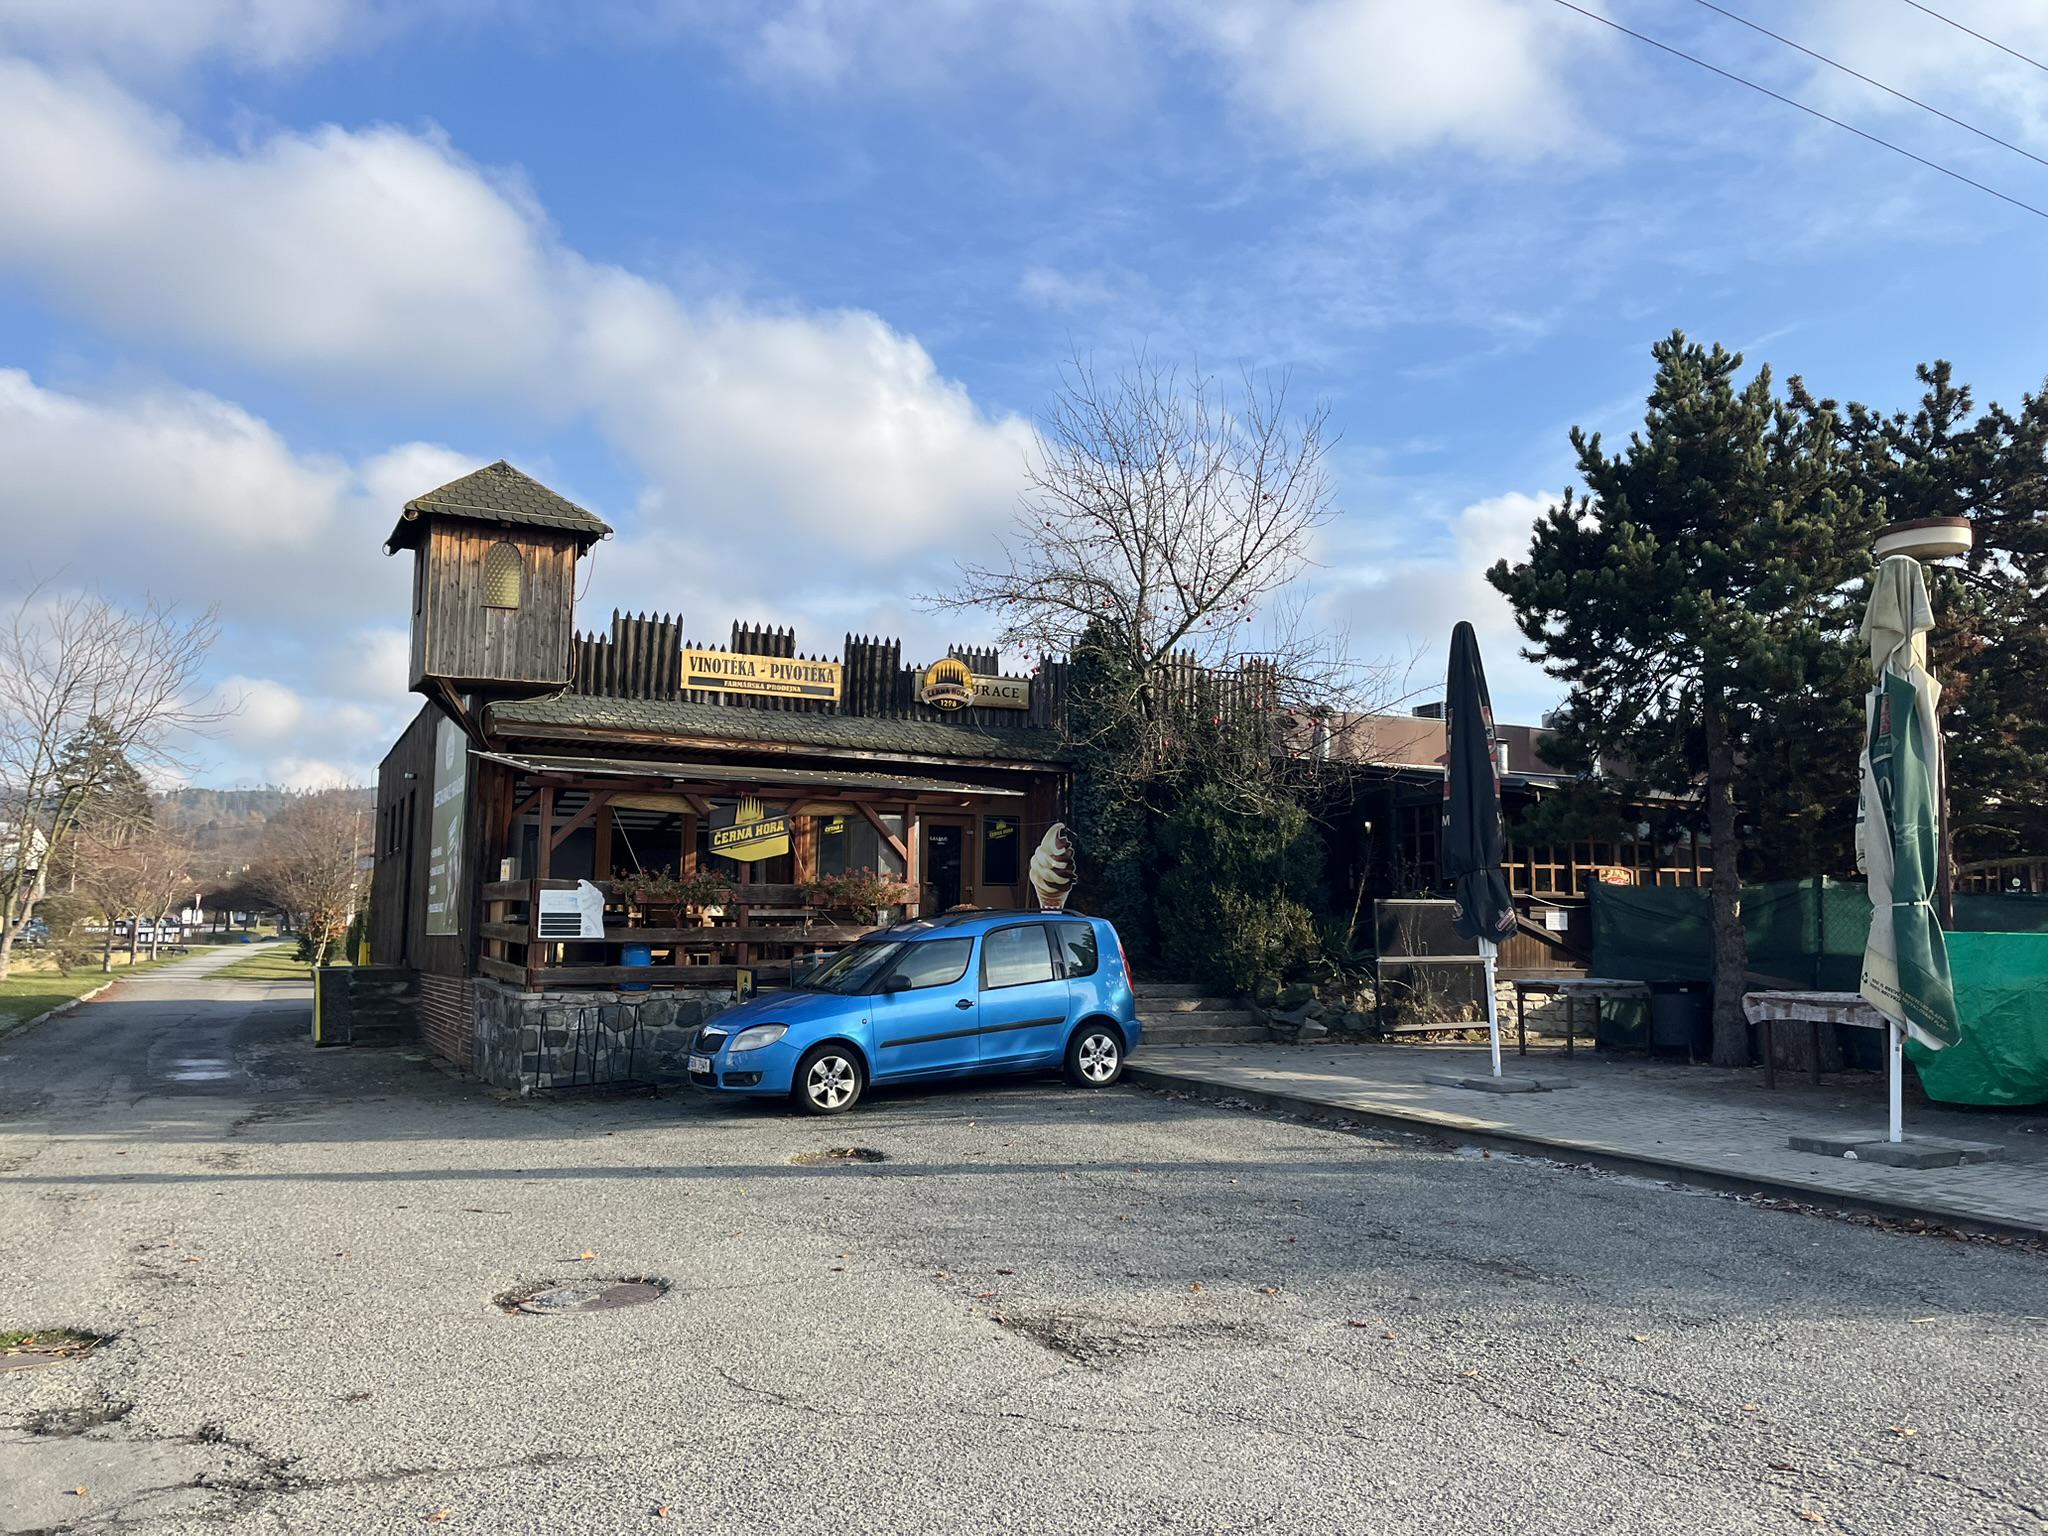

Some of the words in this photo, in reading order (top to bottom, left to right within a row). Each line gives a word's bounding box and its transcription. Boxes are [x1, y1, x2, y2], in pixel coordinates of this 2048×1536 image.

[689, 656, 756, 677] VINOTÉKA
[770, 663, 835, 683] PIVOTÉKA
[713, 824, 753, 846] ČERNÁ
[755, 820, 785, 837] HORA
